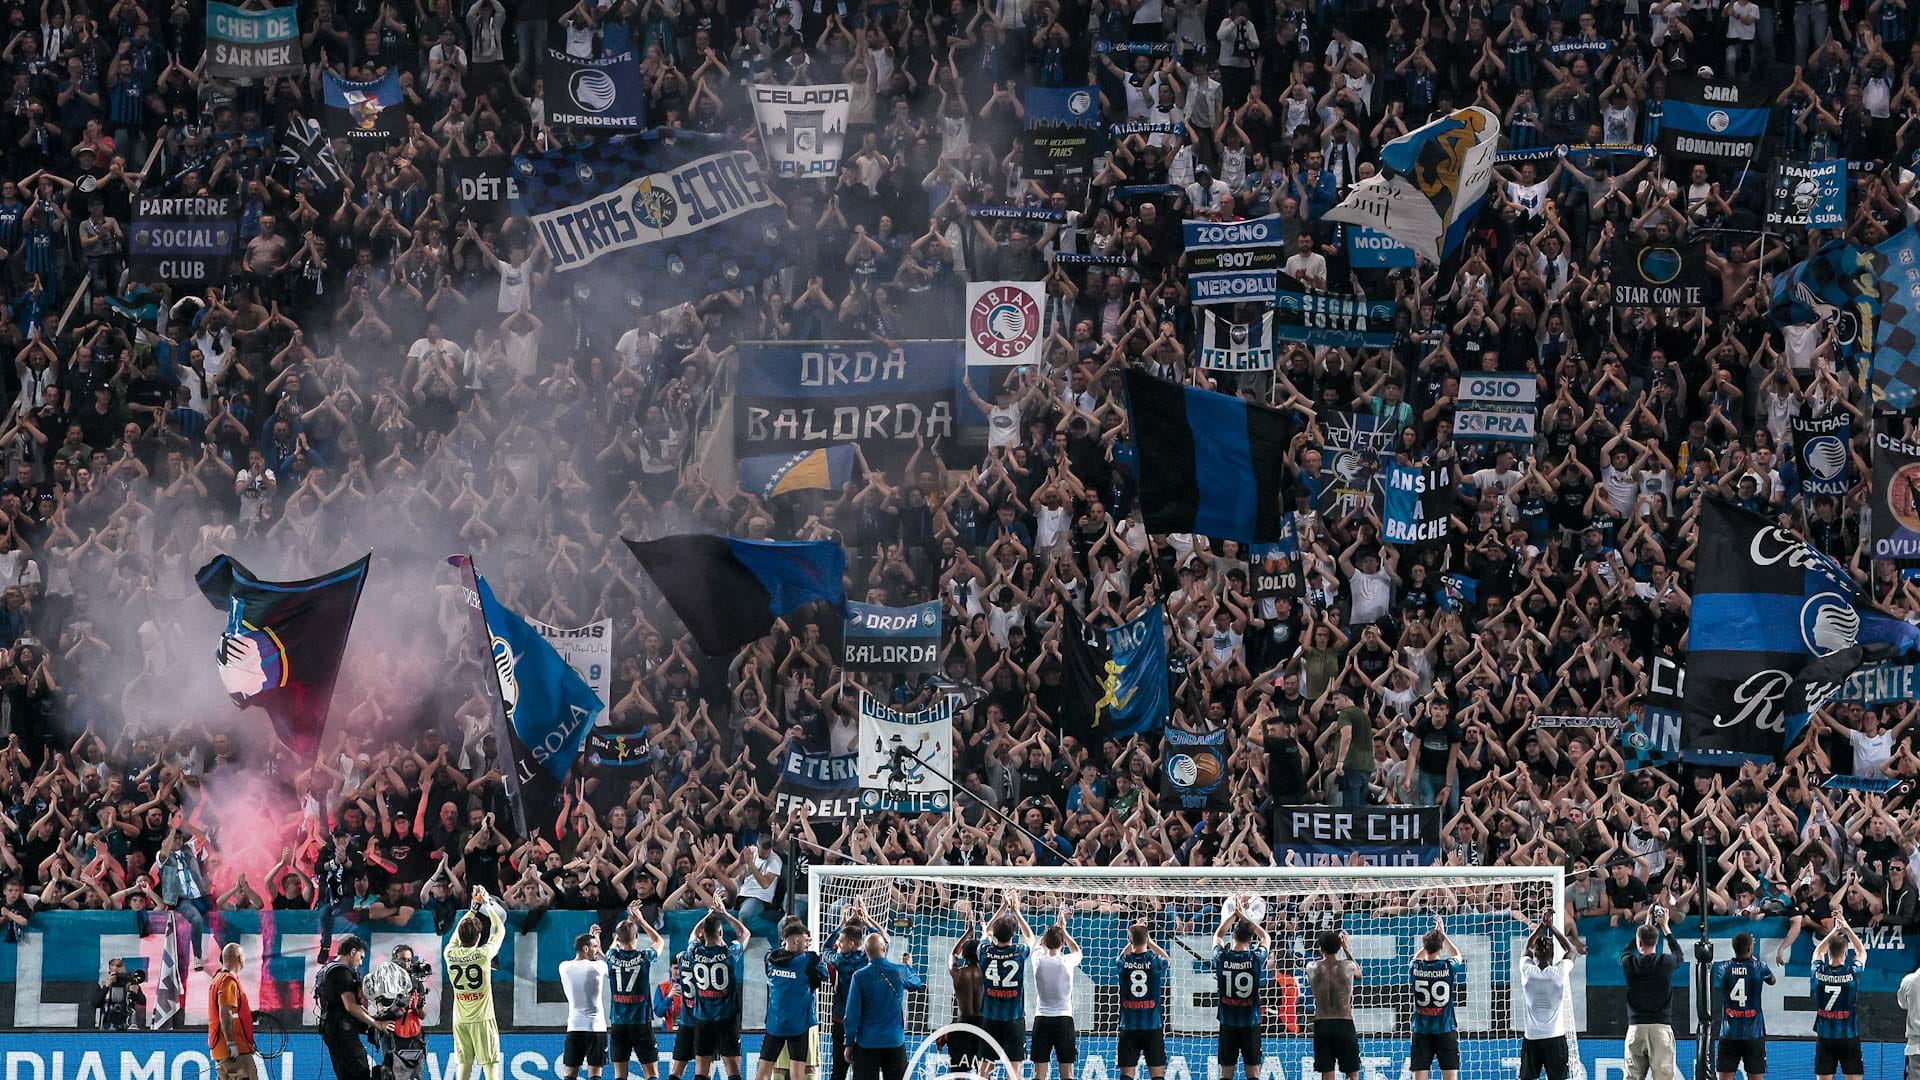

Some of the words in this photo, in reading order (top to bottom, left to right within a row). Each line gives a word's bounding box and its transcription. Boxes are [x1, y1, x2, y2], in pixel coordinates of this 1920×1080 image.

[216, 15, 258, 39] CHEI
[267, 17, 290, 39] DE
[215, 44, 290, 67] SARNEK
[1552, 42, 1607, 52] BERGAMO
[757, 89, 849, 104] CELADA
[1704, 85, 1739, 102] SARÀ
[552, 113, 638, 126] DIPENDENTE
[1115, 121, 1162, 135] ATALANTA
[1049, 148, 1073, 156] FANS
[1677, 136, 1753, 157] ROMANTICO
[1780, 165, 1784, 175] I
[1786, 165, 1836, 178] RANDAGI
[139, 198, 229, 216] PARTERRE
[1026, 208, 1052, 219] 1907
[151, 229, 213, 248] SOCIAL
[540, 194, 637, 266] ULTRAS
[1197, 224, 1268, 243] ZOGNO
[1054, 255, 1127, 264] BERGAMO
[1216, 252, 1254, 268] 1907
[160, 261, 205, 279] CLUB
[1197, 277, 1277, 296] NEROBLU
[1615, 286, 1649, 303] STAR
[1653, 287, 1681, 303] CON
[1686, 286, 1700, 304] TE
[975, 288, 1034, 315] UBIAL
[1303, 295, 1368, 316] SEGNA
[1304, 312, 1367, 331] LOTTA
[801, 349, 905, 386] ORDA
[1470, 381, 1520, 397] OSIO
[747, 402, 951, 441] BALORDA
[1793, 413, 1849, 433] ULTRAS
[1390, 467, 1449, 493] ANSIA
[1413, 500, 1424, 519] A
[1386, 516, 1447, 541] BRACHE
[1257, 573, 1296, 591] SOLTO
[866, 614, 918, 630] ORDA
[846, 645, 937, 663] BALORDA
[865, 697, 945, 724] UBRIACHI
[532, 704, 588, 764] SOLA
[787, 756, 859, 780] ETERN
[775, 792, 864, 817] FEDELT
[909, 793, 931, 811] TE
[1293, 812, 1353, 840] PER
[1368, 813, 1420, 841] CHI
[449, 964, 483, 990] 29
[612, 965, 641, 992] 17
[693, 962, 729, 991] 90
[985, 959, 1020, 988] 42
[1731, 966, 1748, 976] HIEN
[1130, 969, 1148, 998] 8
[1222, 971, 1254, 999] 19
[1729, 977, 1748, 1008] 4
[1414, 980, 1450, 1008] 59
[1824, 985, 1842, 1011] 7
